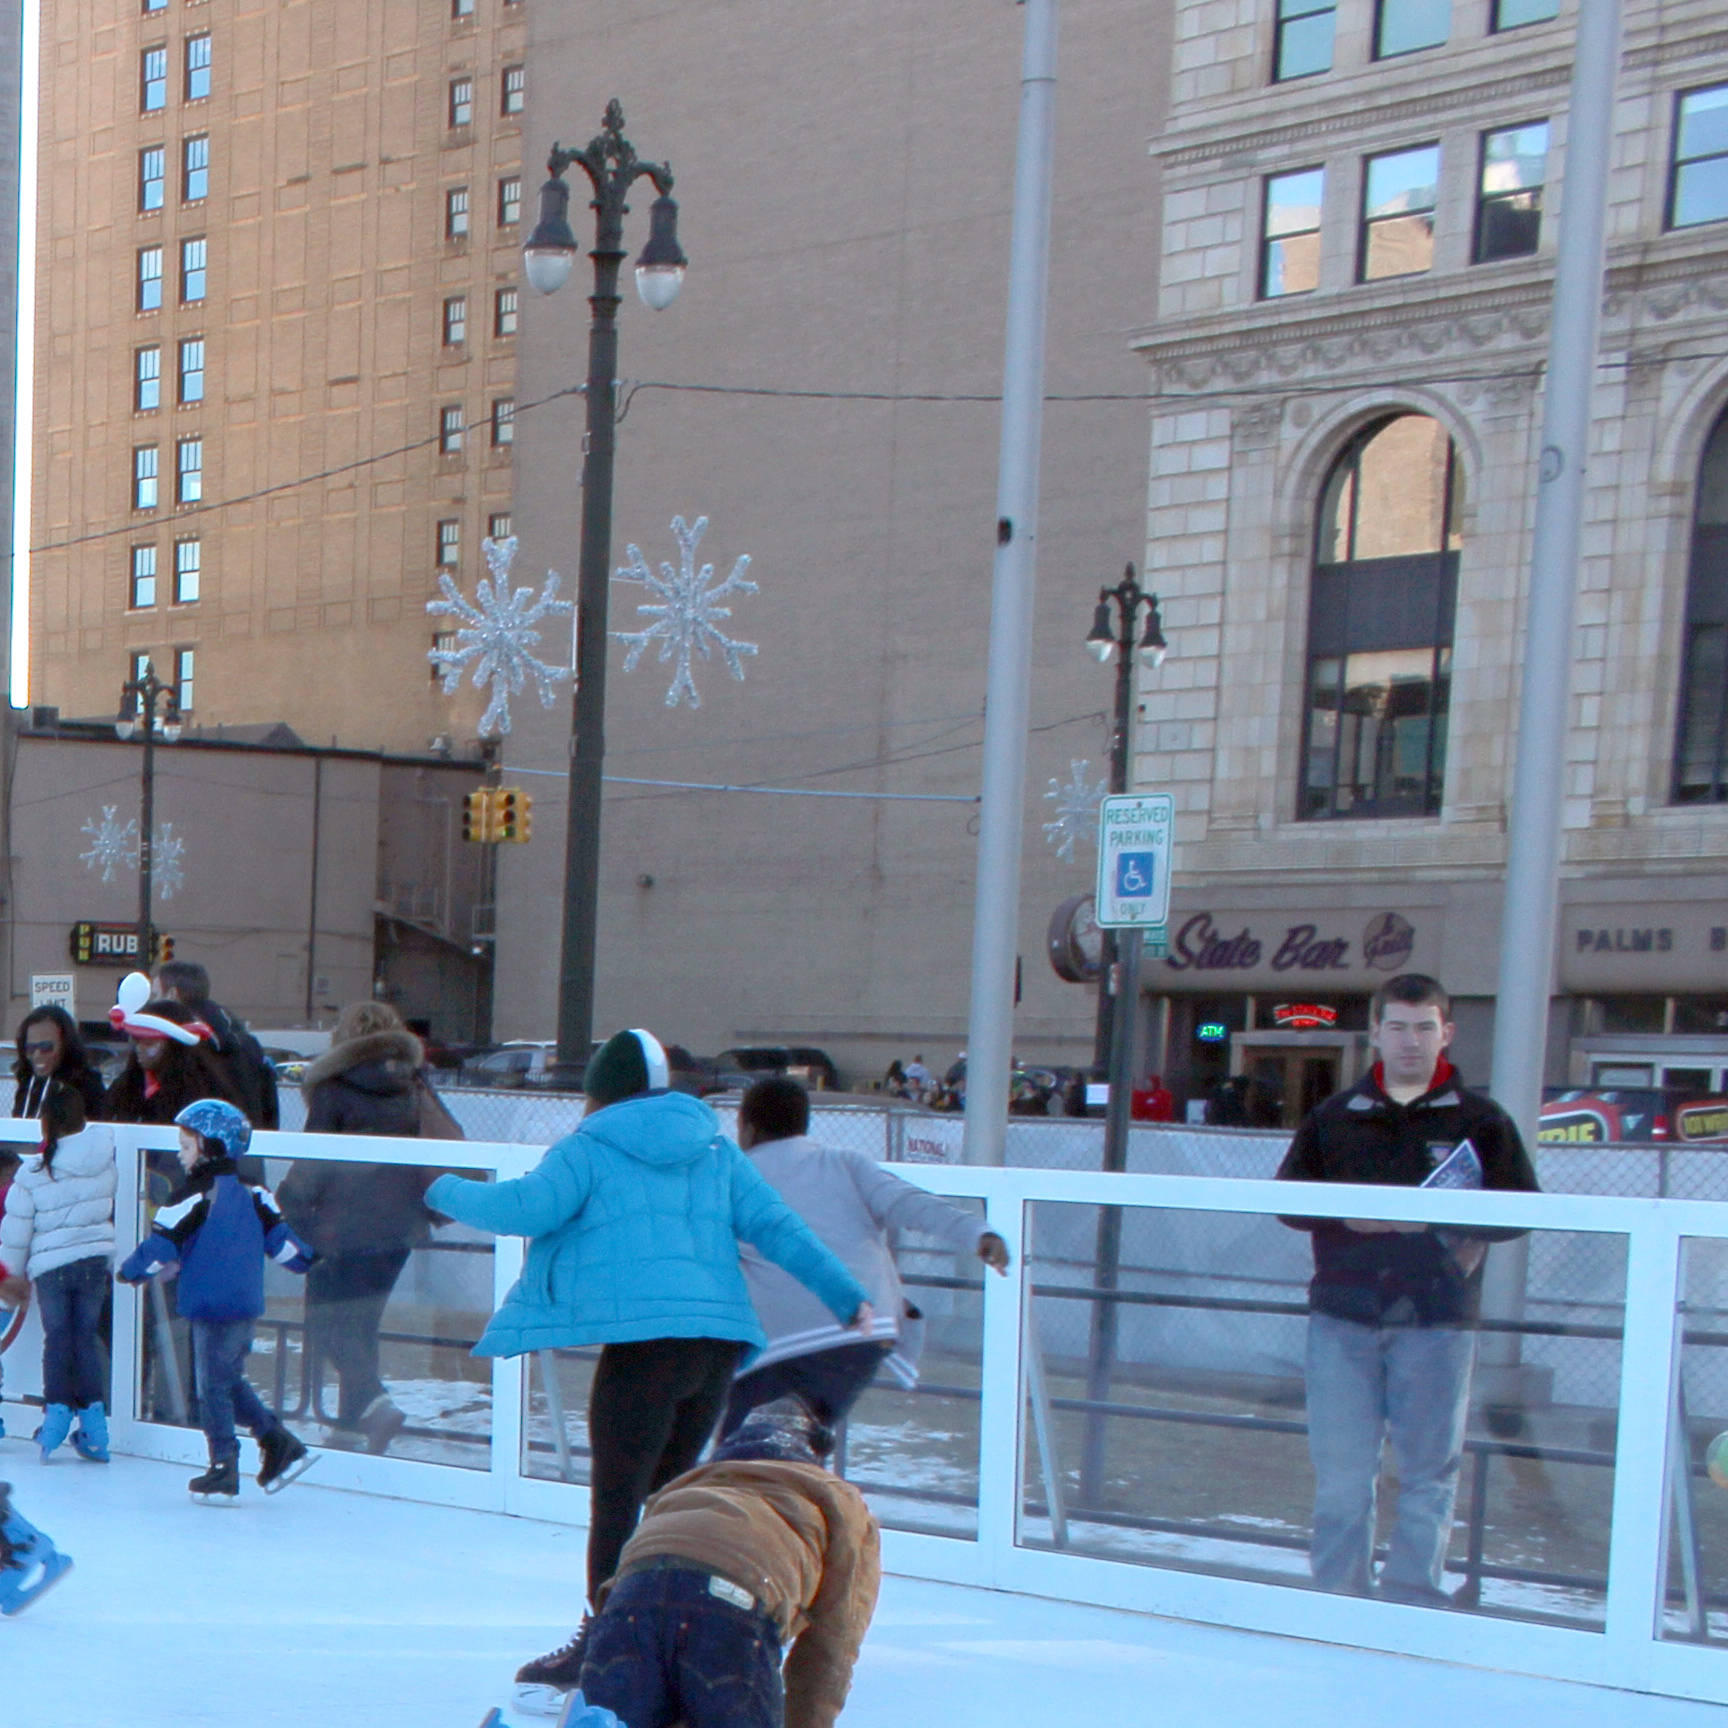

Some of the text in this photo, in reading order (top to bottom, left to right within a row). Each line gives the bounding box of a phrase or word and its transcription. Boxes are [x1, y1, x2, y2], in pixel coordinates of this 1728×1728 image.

[1106, 807, 1168, 824] RESERVED
[1110, 829, 1163, 847] PARKING
[97, 933, 139, 954] RUB
[1165, 912, 1350, 971] State Bar
[1577, 928, 1673, 951] PALMS
[34, 981, 71, 994] SPEED
[1199, 1025, 1224, 1038] ATM
